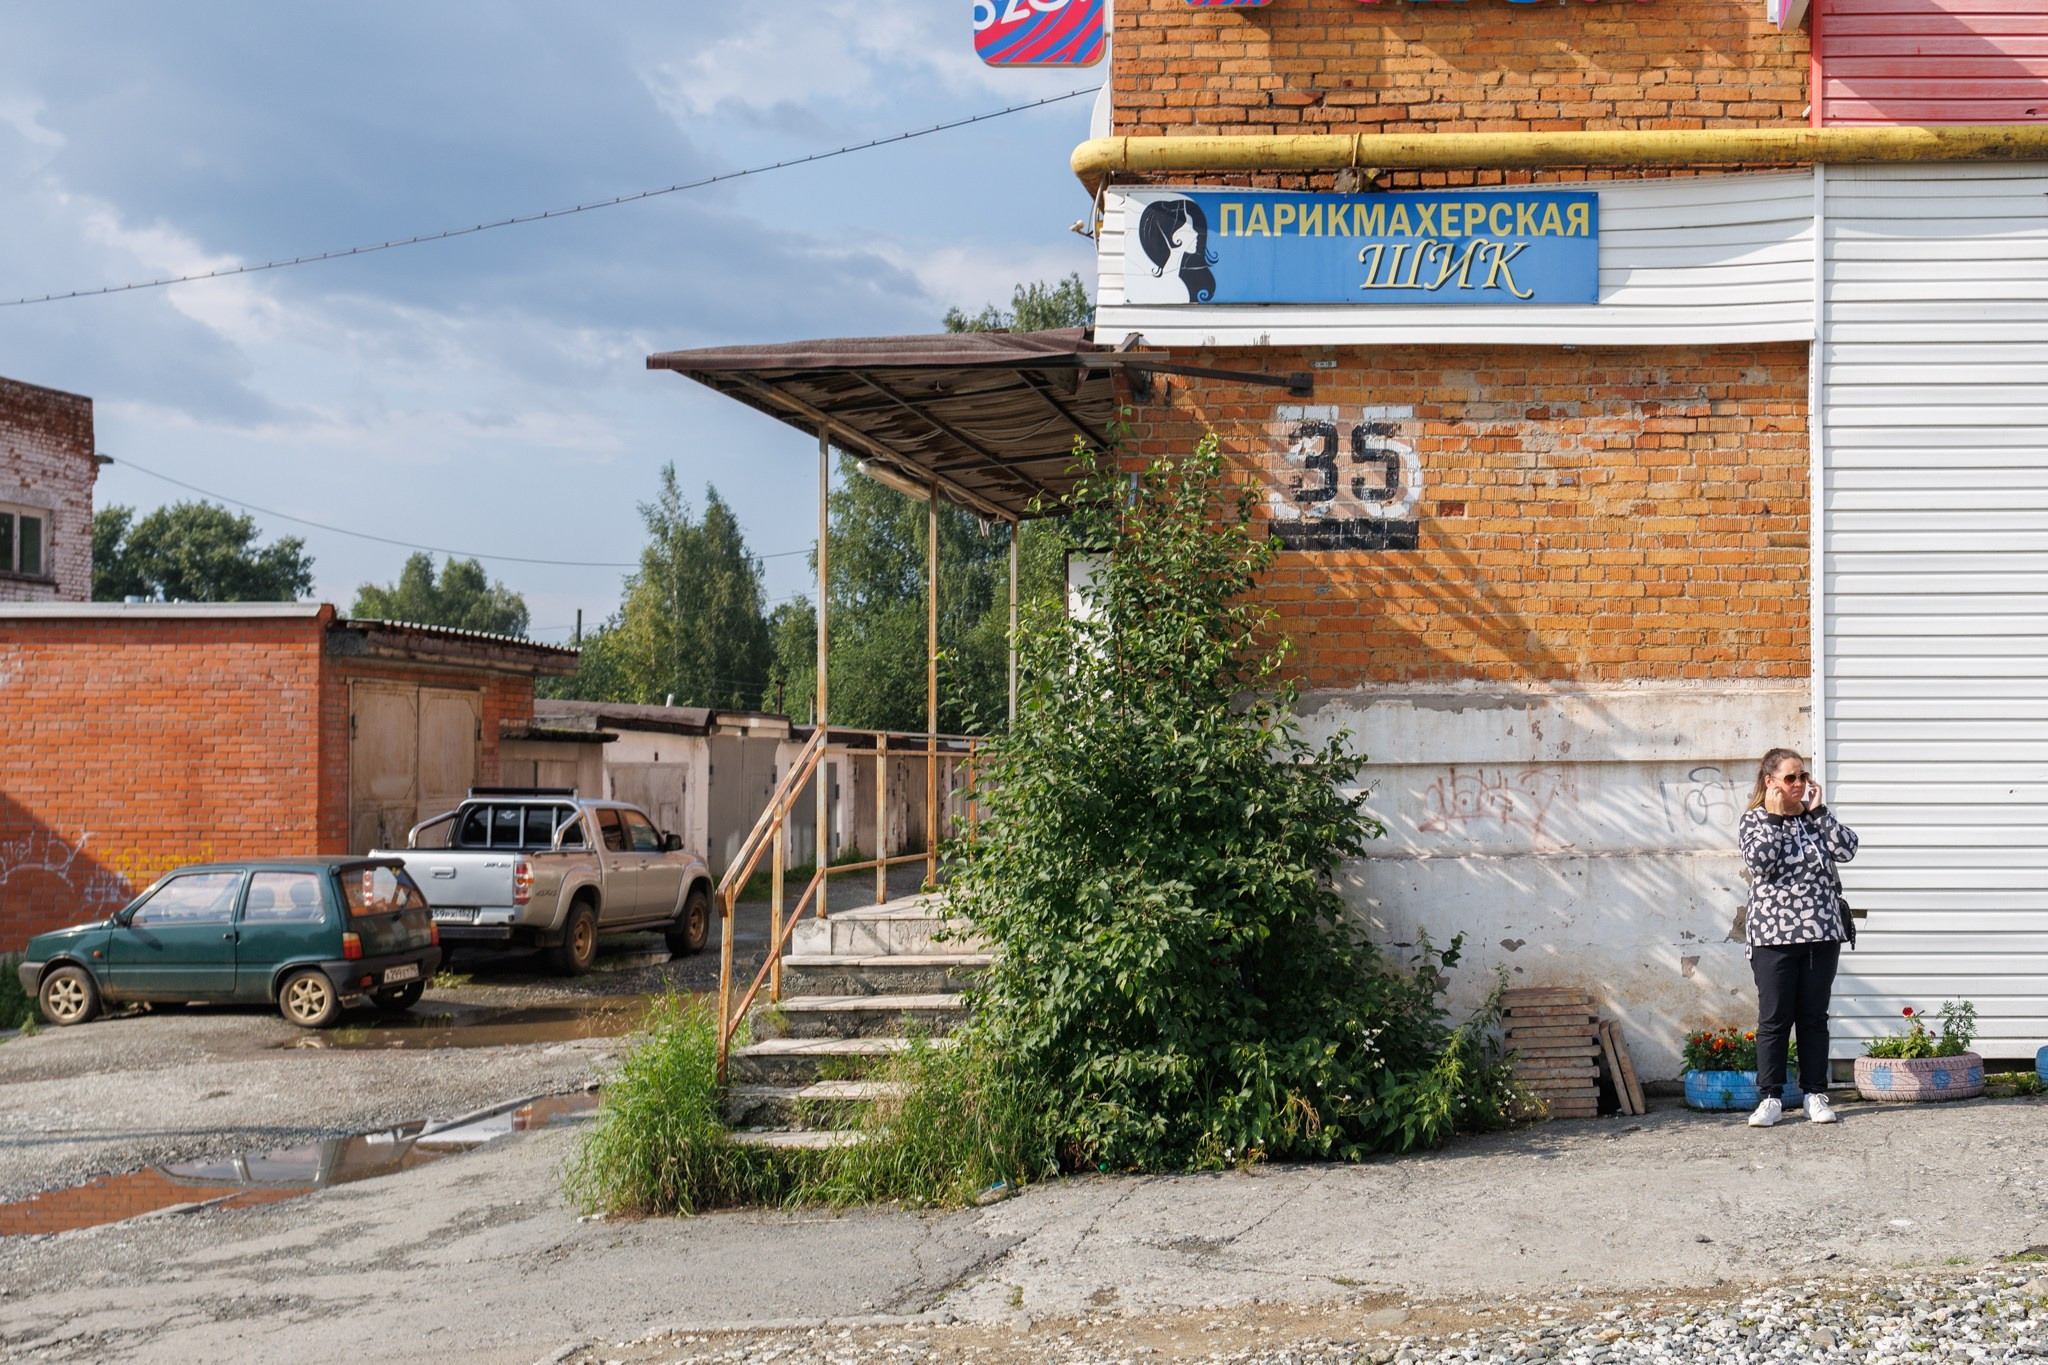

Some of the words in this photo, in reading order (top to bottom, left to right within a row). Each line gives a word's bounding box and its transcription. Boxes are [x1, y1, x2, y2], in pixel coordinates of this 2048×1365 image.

[1219, 202, 1590, 237] ПАРИКМАХЕРСКАЯ
[1358, 238, 1534, 300] ШИК
[1286, 419, 1403, 504] 35
